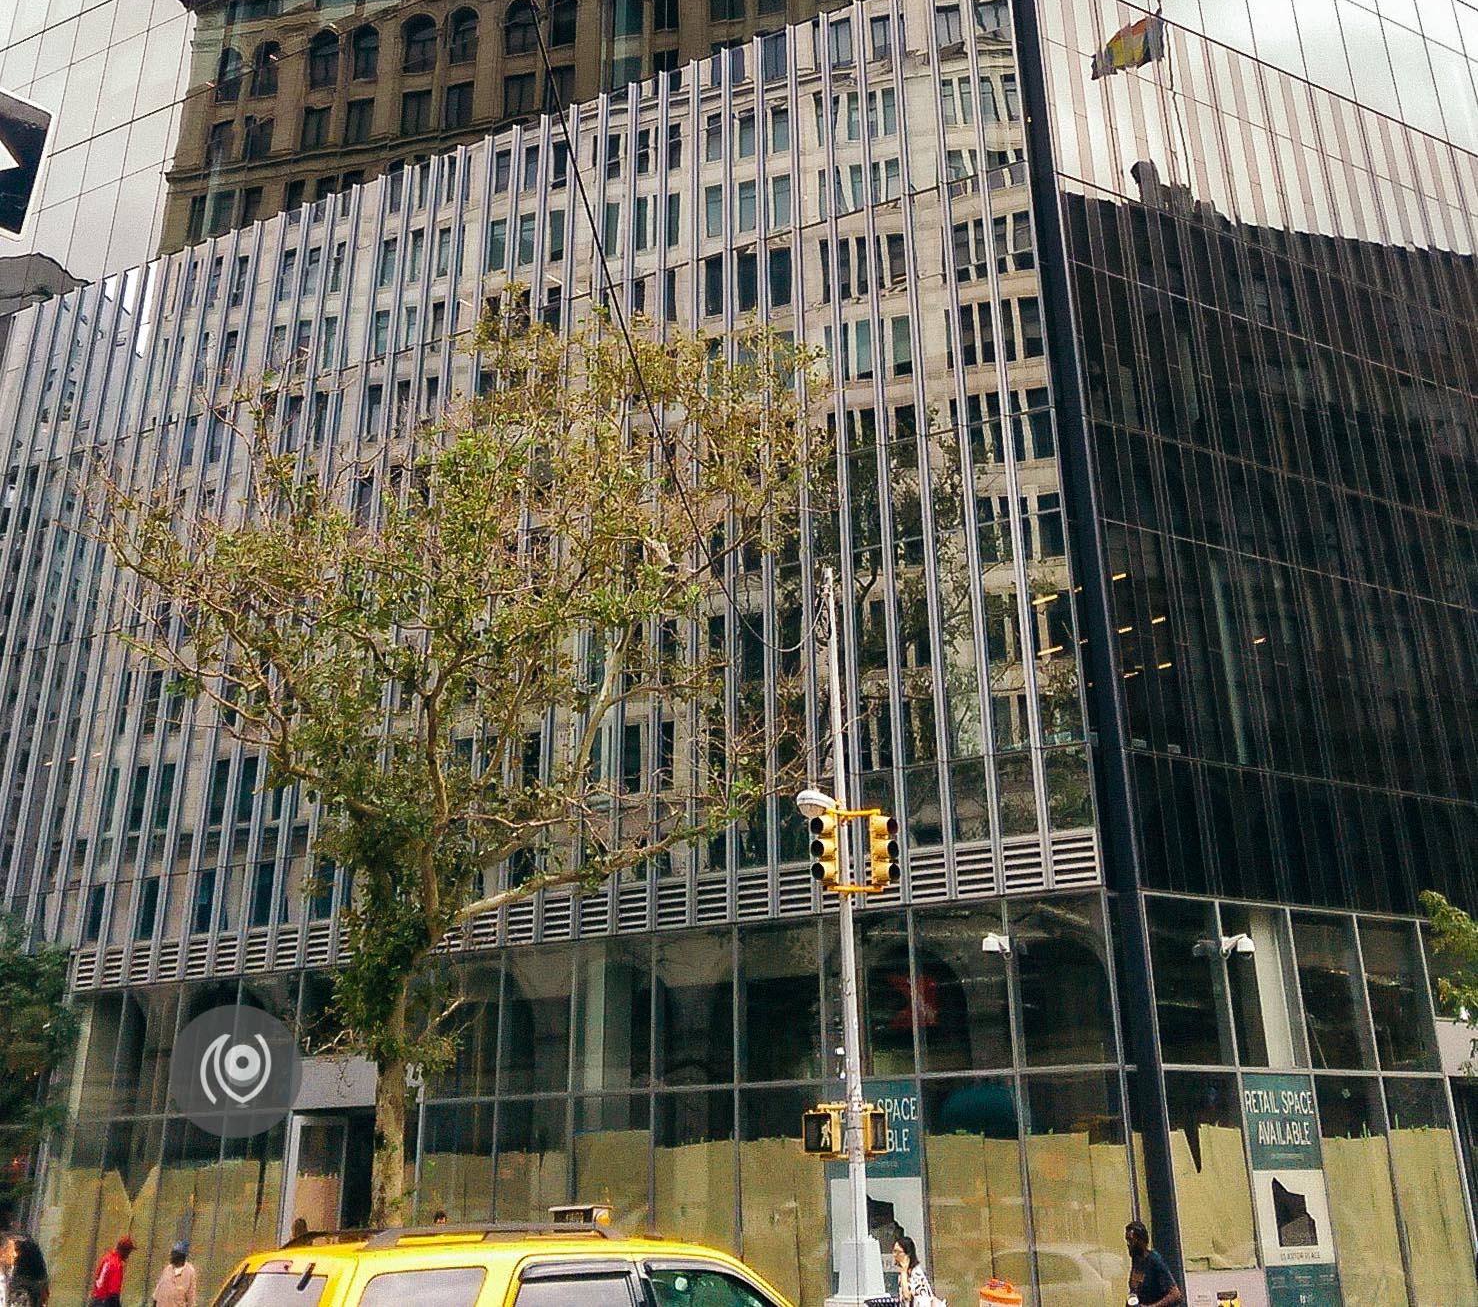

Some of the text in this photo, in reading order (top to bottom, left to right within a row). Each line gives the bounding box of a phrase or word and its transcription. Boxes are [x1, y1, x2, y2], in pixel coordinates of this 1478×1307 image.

[1244, 1090, 1314, 1114] RETAIL SPACE
[1258, 1121, 1312, 1145] AVAILABLE
